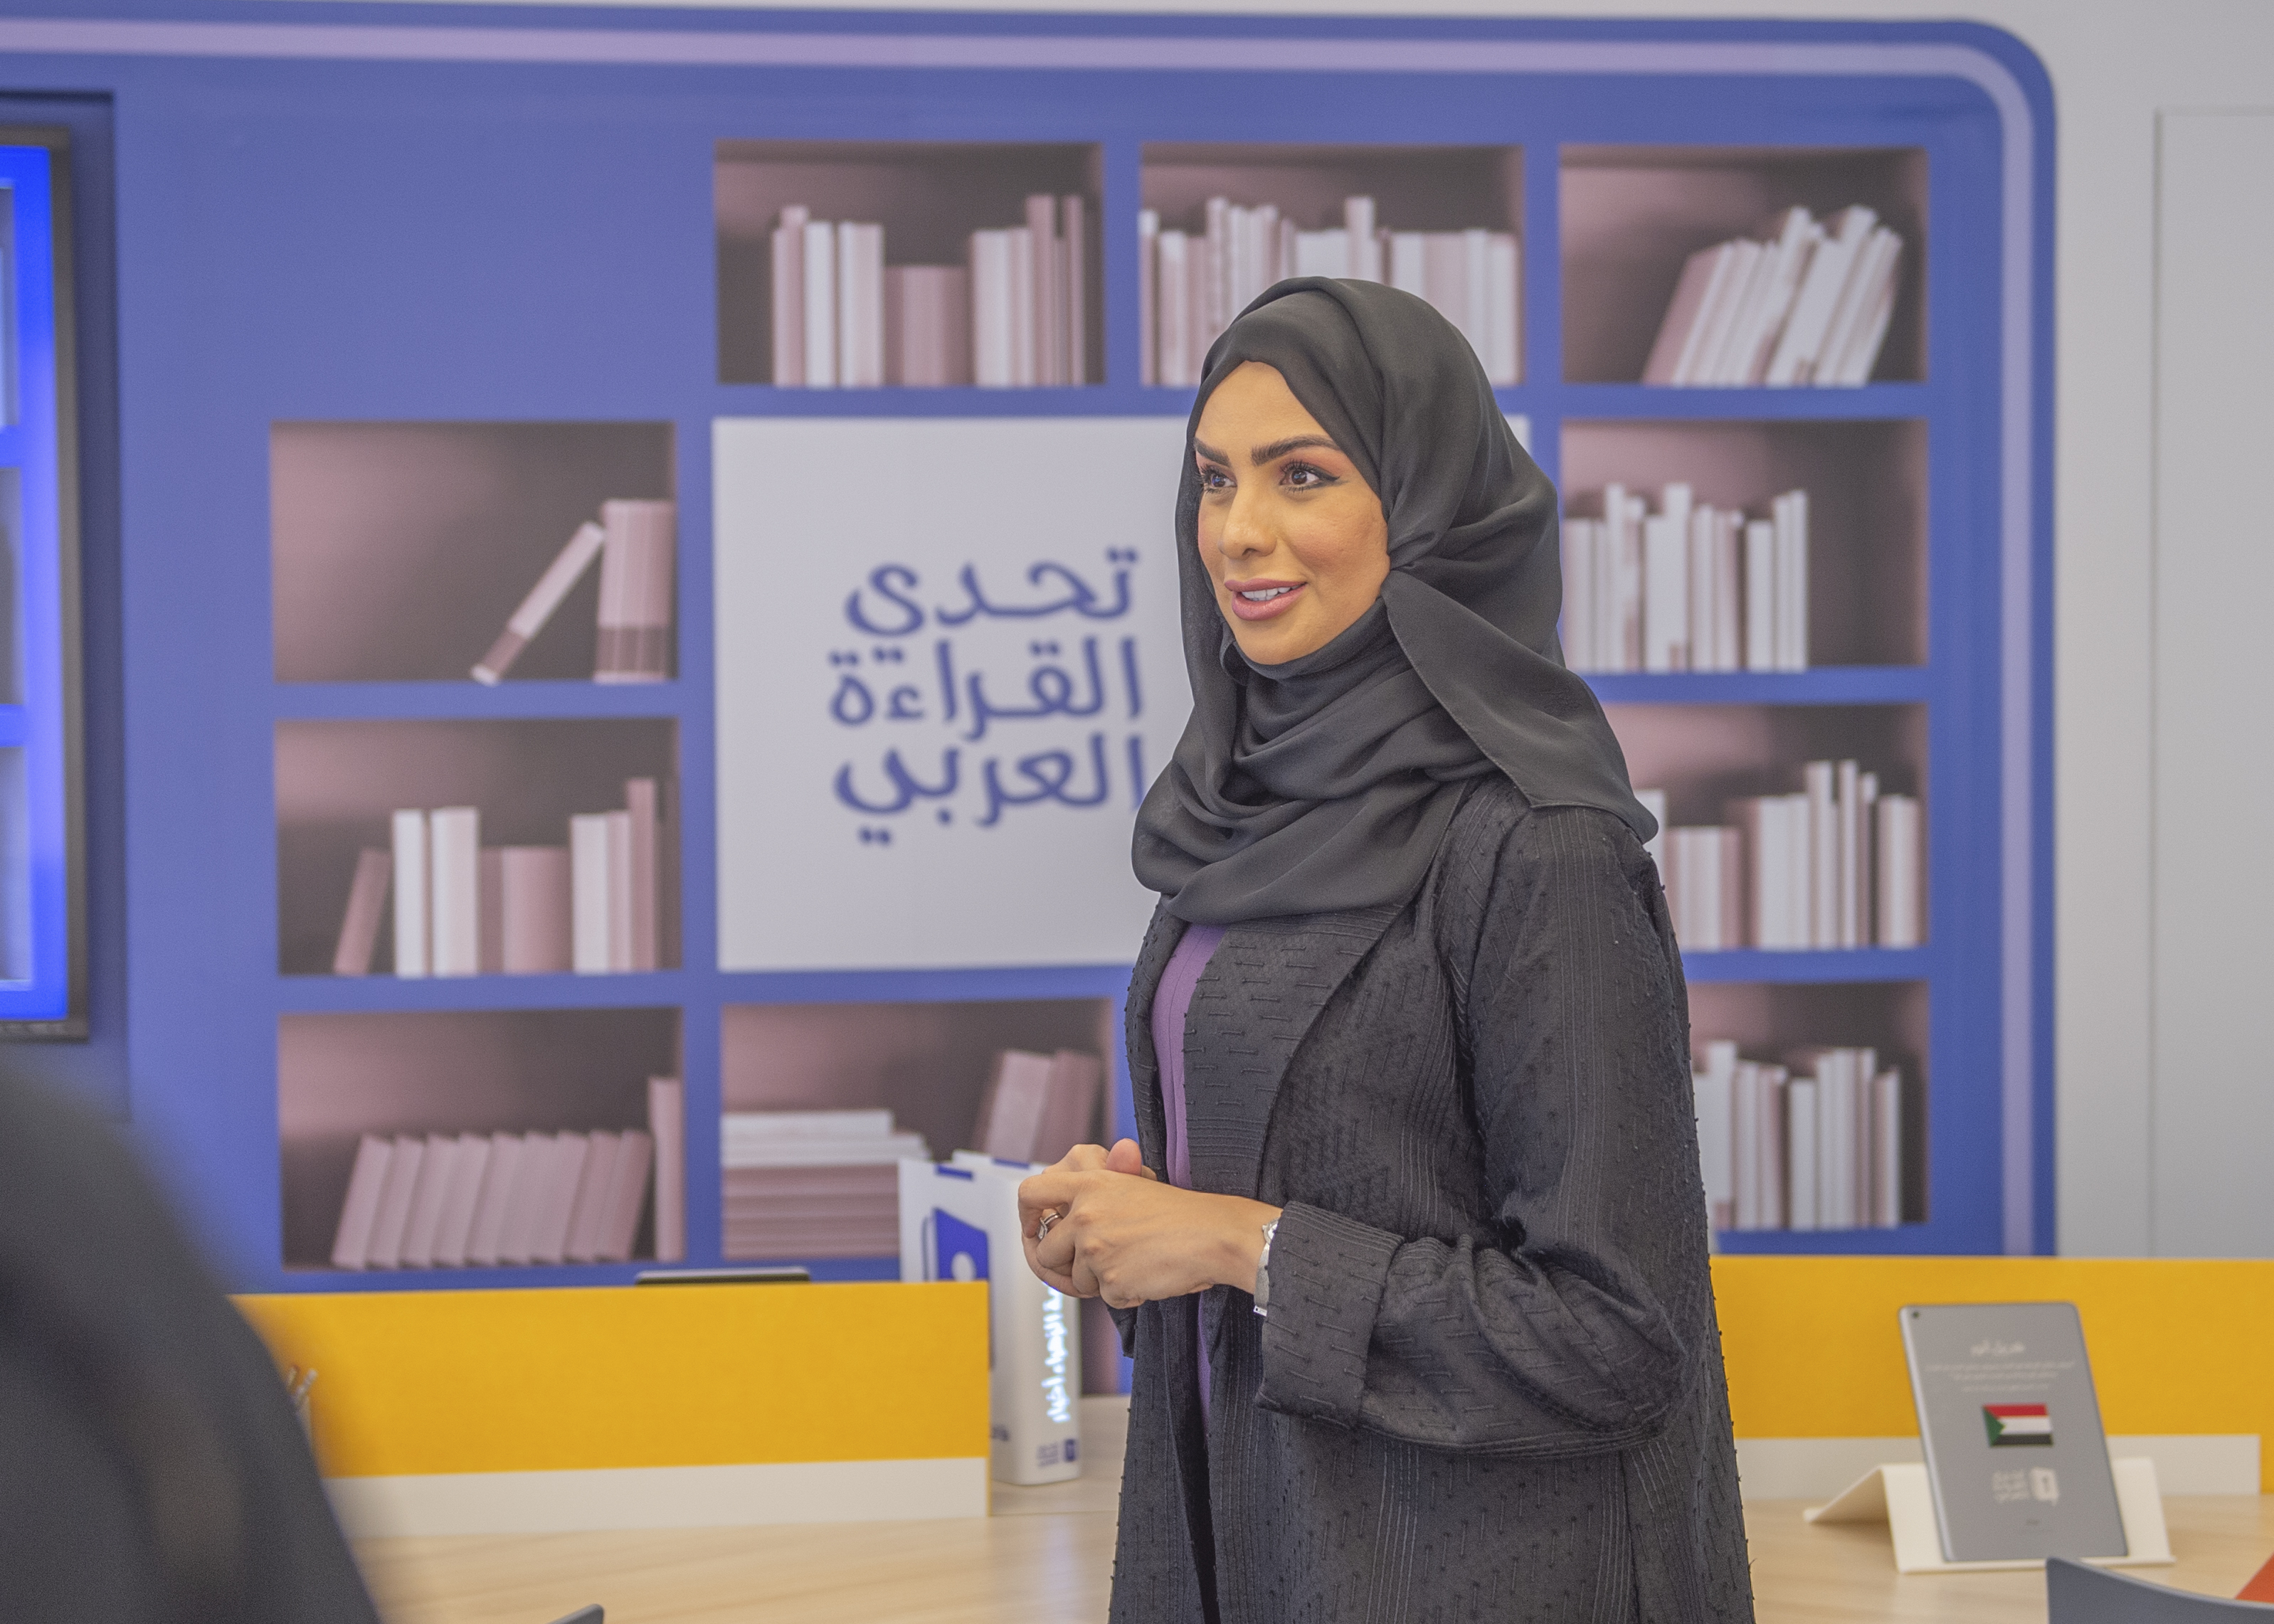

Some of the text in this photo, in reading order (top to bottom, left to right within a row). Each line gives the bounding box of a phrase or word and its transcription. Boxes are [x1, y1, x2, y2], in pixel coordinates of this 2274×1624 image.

[844, 546, 1139, 664] تحدي
[828, 635, 1143, 742] القراءة
[833, 733, 1147, 846] العربي
